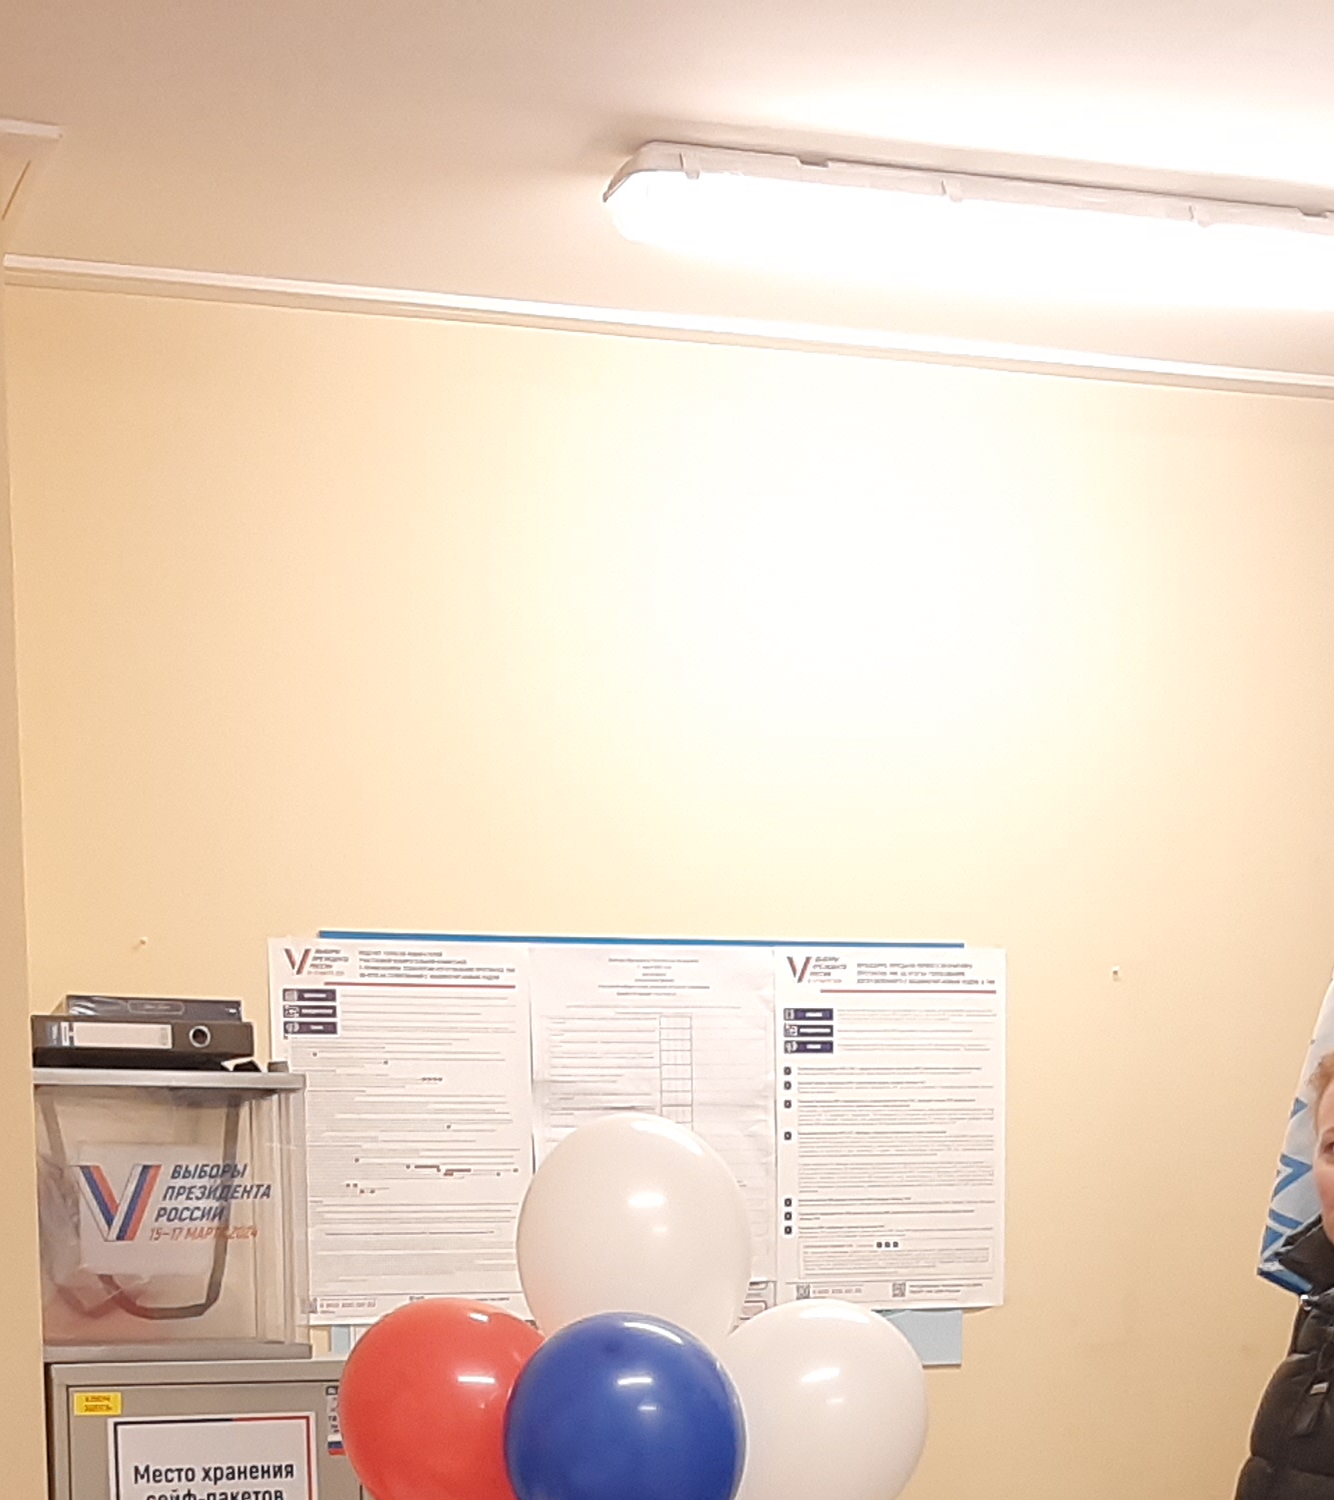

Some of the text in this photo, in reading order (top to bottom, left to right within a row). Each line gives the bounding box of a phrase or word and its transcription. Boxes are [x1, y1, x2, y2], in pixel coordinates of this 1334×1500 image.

[171, 1164, 248, 1179] ВЫБОРЫ
[162, 1184, 272, 1202] ПРЕЗИДЕНТА
[154, 1207, 224, 1222] РОССИИ
[133, 1463, 295, 1490] Место хранения
